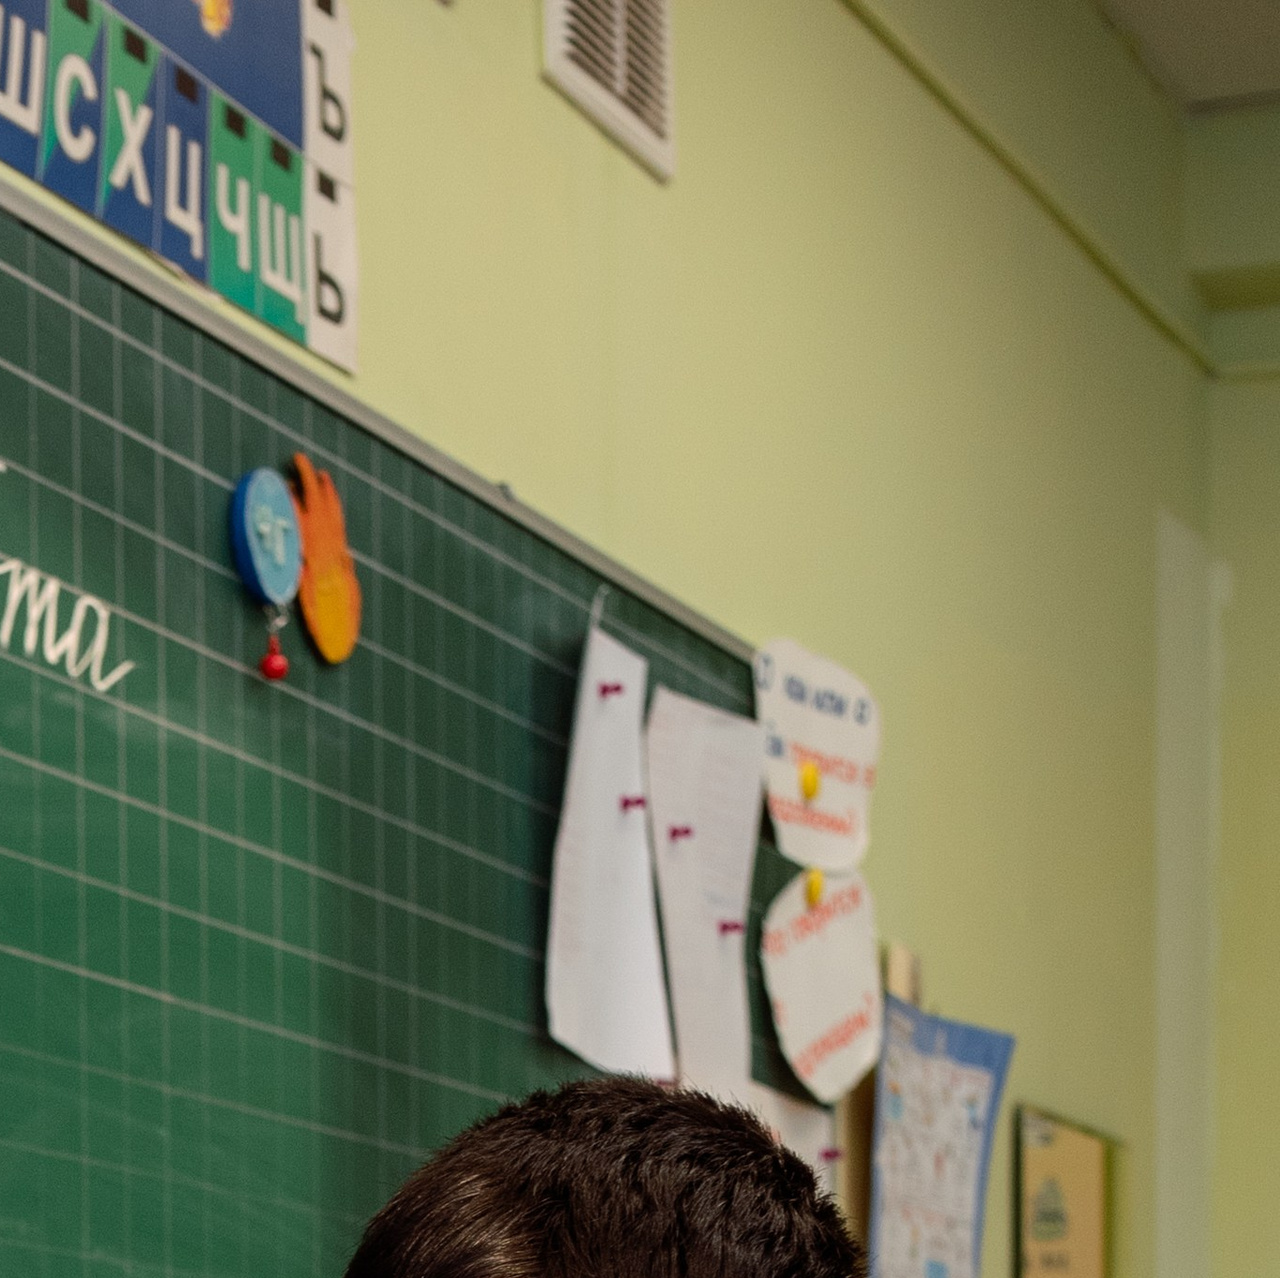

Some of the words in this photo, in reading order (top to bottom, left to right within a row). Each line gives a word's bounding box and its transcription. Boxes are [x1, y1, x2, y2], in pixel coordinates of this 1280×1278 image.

[53, 53, 98, 164] С
[109, 86, 154, 207] Х
[165, 124, 204, 260] Ц
[216, 162, 252, 273] Ч
[257, 192, 306, 326] Щ
